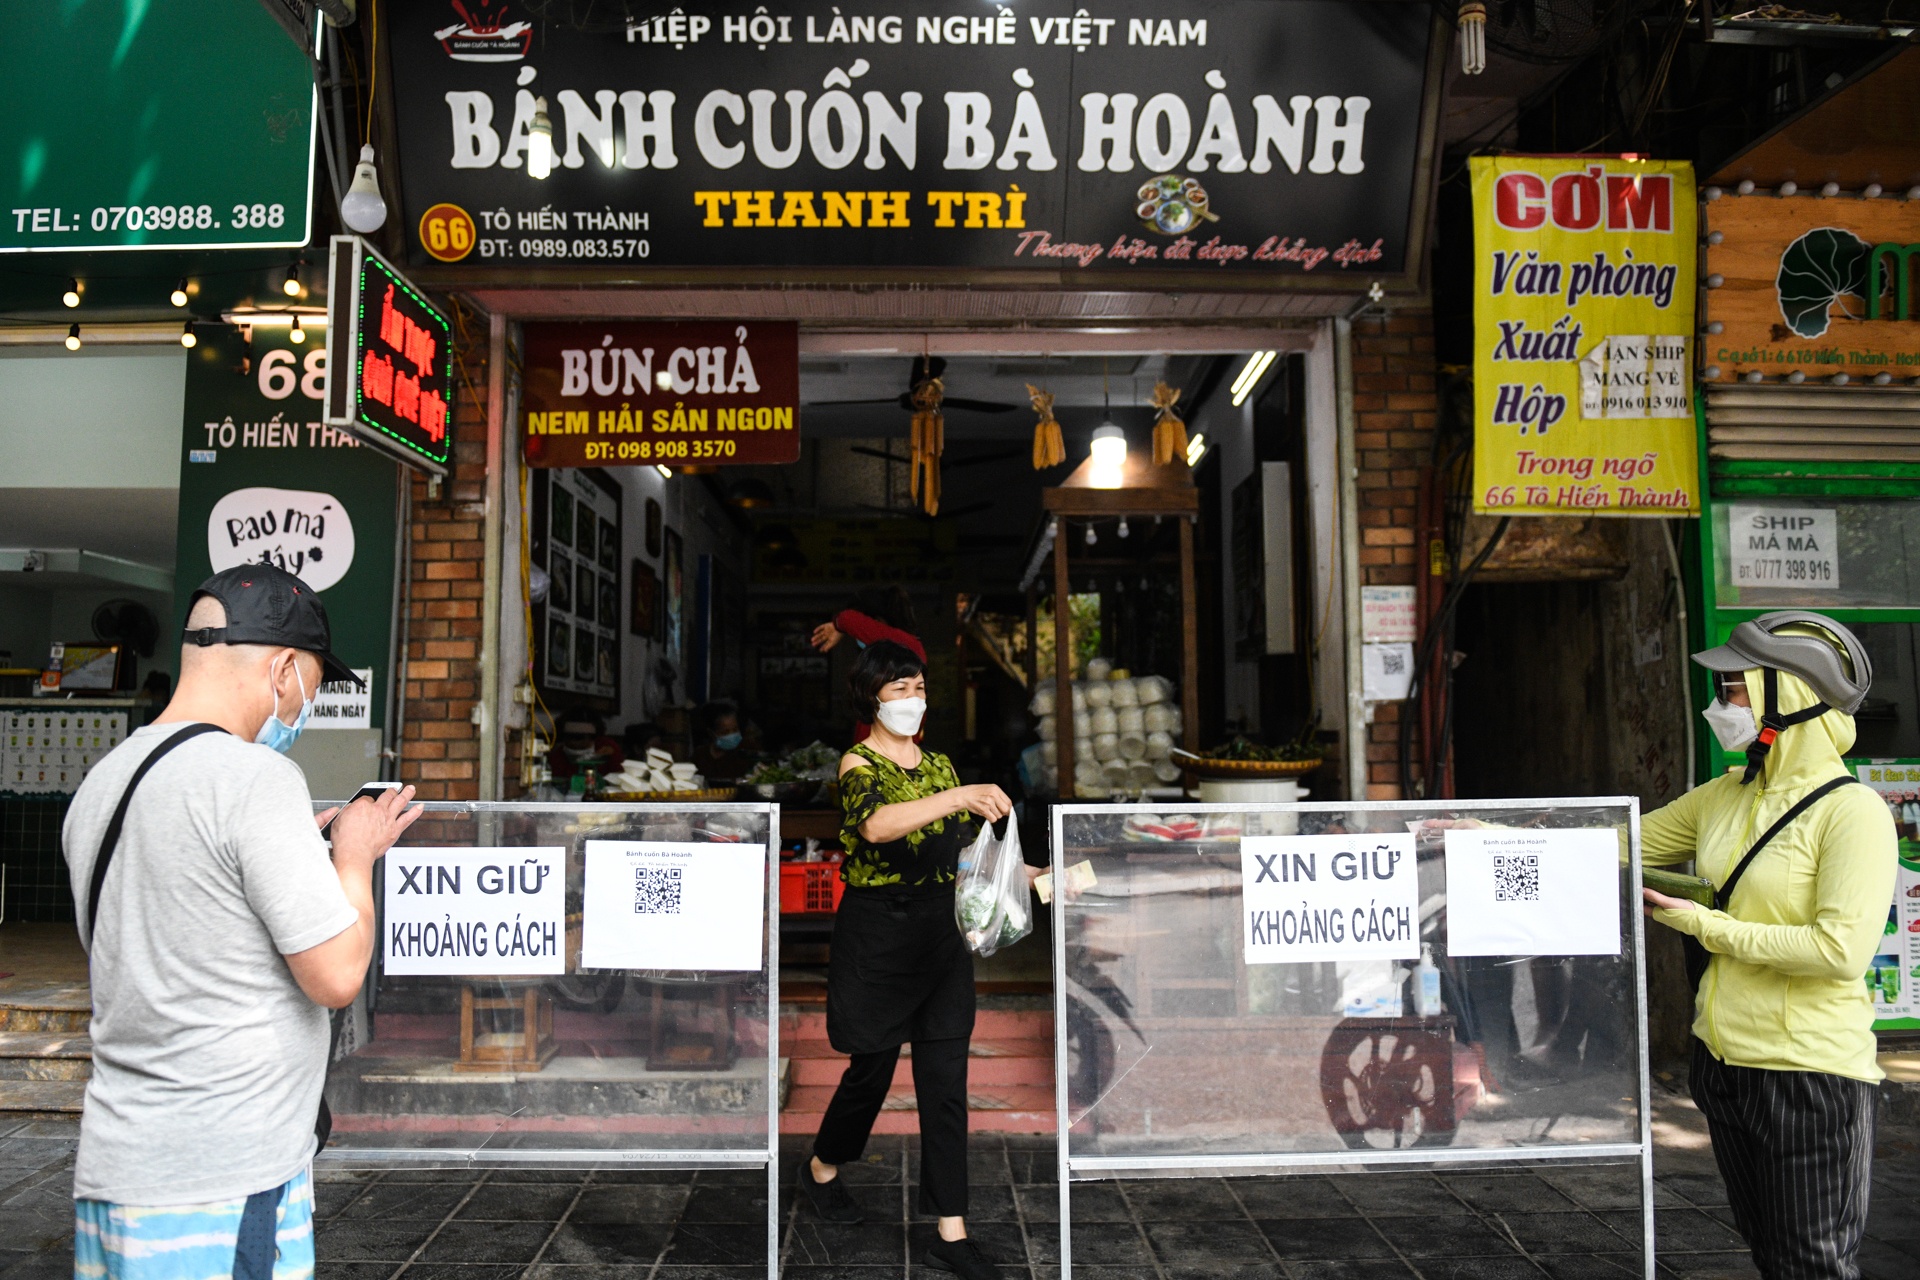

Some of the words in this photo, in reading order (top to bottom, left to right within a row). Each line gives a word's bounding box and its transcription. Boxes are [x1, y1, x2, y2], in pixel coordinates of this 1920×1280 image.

[626, 8, 711, 50] HIỆP
[723, 6, 792, 50] HỘI
[807, 7, 902, 43] LÀNG
[917, 5, 1016, 44] NGHỀ
[1030, 9, 1115, 51] VIỆT
[1128, 18, 1207, 46] NAM
[445, 66, 679, 170] BÁNH
[694, 58, 923, 171] CUỐN
[943, 68, 1058, 171] BÀ
[1078, 69, 1371, 175] HOÀNH
[695, 191, 911, 228] THANH
[927, 184, 1027, 229] TRÌ
[1494, 164, 1674, 233] CƠM
[12, 209, 80, 233] TEL:
[91, 206, 220, 231] 0703988.
[231, 204, 285, 229] 388
[428, 216, 468, 250] 66
[480, 208, 511, 231] TÔ
[517, 204, 568, 231] HIẾN
[574, 205, 649, 231] THÀNH
[479, 239, 513, 257] ĐT:
[519, 239, 650, 259] 0989.083.570
[1492, 250, 1561, 296] Văn
[1567, 249, 1677, 308] phòng
[1492, 314, 1584, 362] Xuất
[1645, 346, 1685, 360] SHIP
[561, 334, 655, 396] BÚN
[667, 326, 760, 395] CHẢ
[1593, 371, 1650, 387] MANG
[528, 411, 590, 435] NEM
[599, 403, 643, 434] HẢI
[652, 402, 708, 432] SẢN
[717, 407, 793, 432] NGON
[1492, 385, 1566, 434] Hộp
[1601, 396, 1633, 409] 0916
[1637, 396, 1661, 409] 013
[205, 416, 236, 447] TÔ
[242, 412, 298, 447] HIẾN
[585, 442, 614, 459] ĐT:
[618, 442, 651, 459] 098
[655, 441, 688, 458] 908
[692, 440, 736, 457] 3570
[1516, 450, 1593, 480] Trong
[1602, 452, 1657, 480] ngõ
[1485, 486, 1516, 507] 66
[1525, 485, 1550, 507] Tô
[1555, 484, 1610, 507] Hiến
[1617, 485, 1689, 508] Thành
[1752, 515, 1815, 530] SHIP
[1749, 533, 1781, 550] MÁ
[1787, 533, 1819, 551] MÀ
[1755, 559, 1782, 579] 0777
[1786, 560, 1806, 580] 398
[1810, 560, 1831, 581] 916
[320, 680, 351, 694] MANG
[314, 702, 339, 717] HÀNG
[342, 702, 366, 718] NGÀY
[397, 865, 461, 895] XIN
[476, 859, 550, 895] GIỮ
[1255, 853, 1316, 883] XIN
[1330, 845, 1401, 882] GIỮ
[391, 914, 488, 957] KHOẢNG
[495, 913, 556, 957] CÁCH
[1251, 901, 1345, 945] KHOẢNG
[1352, 899, 1411, 942] CÁCH
